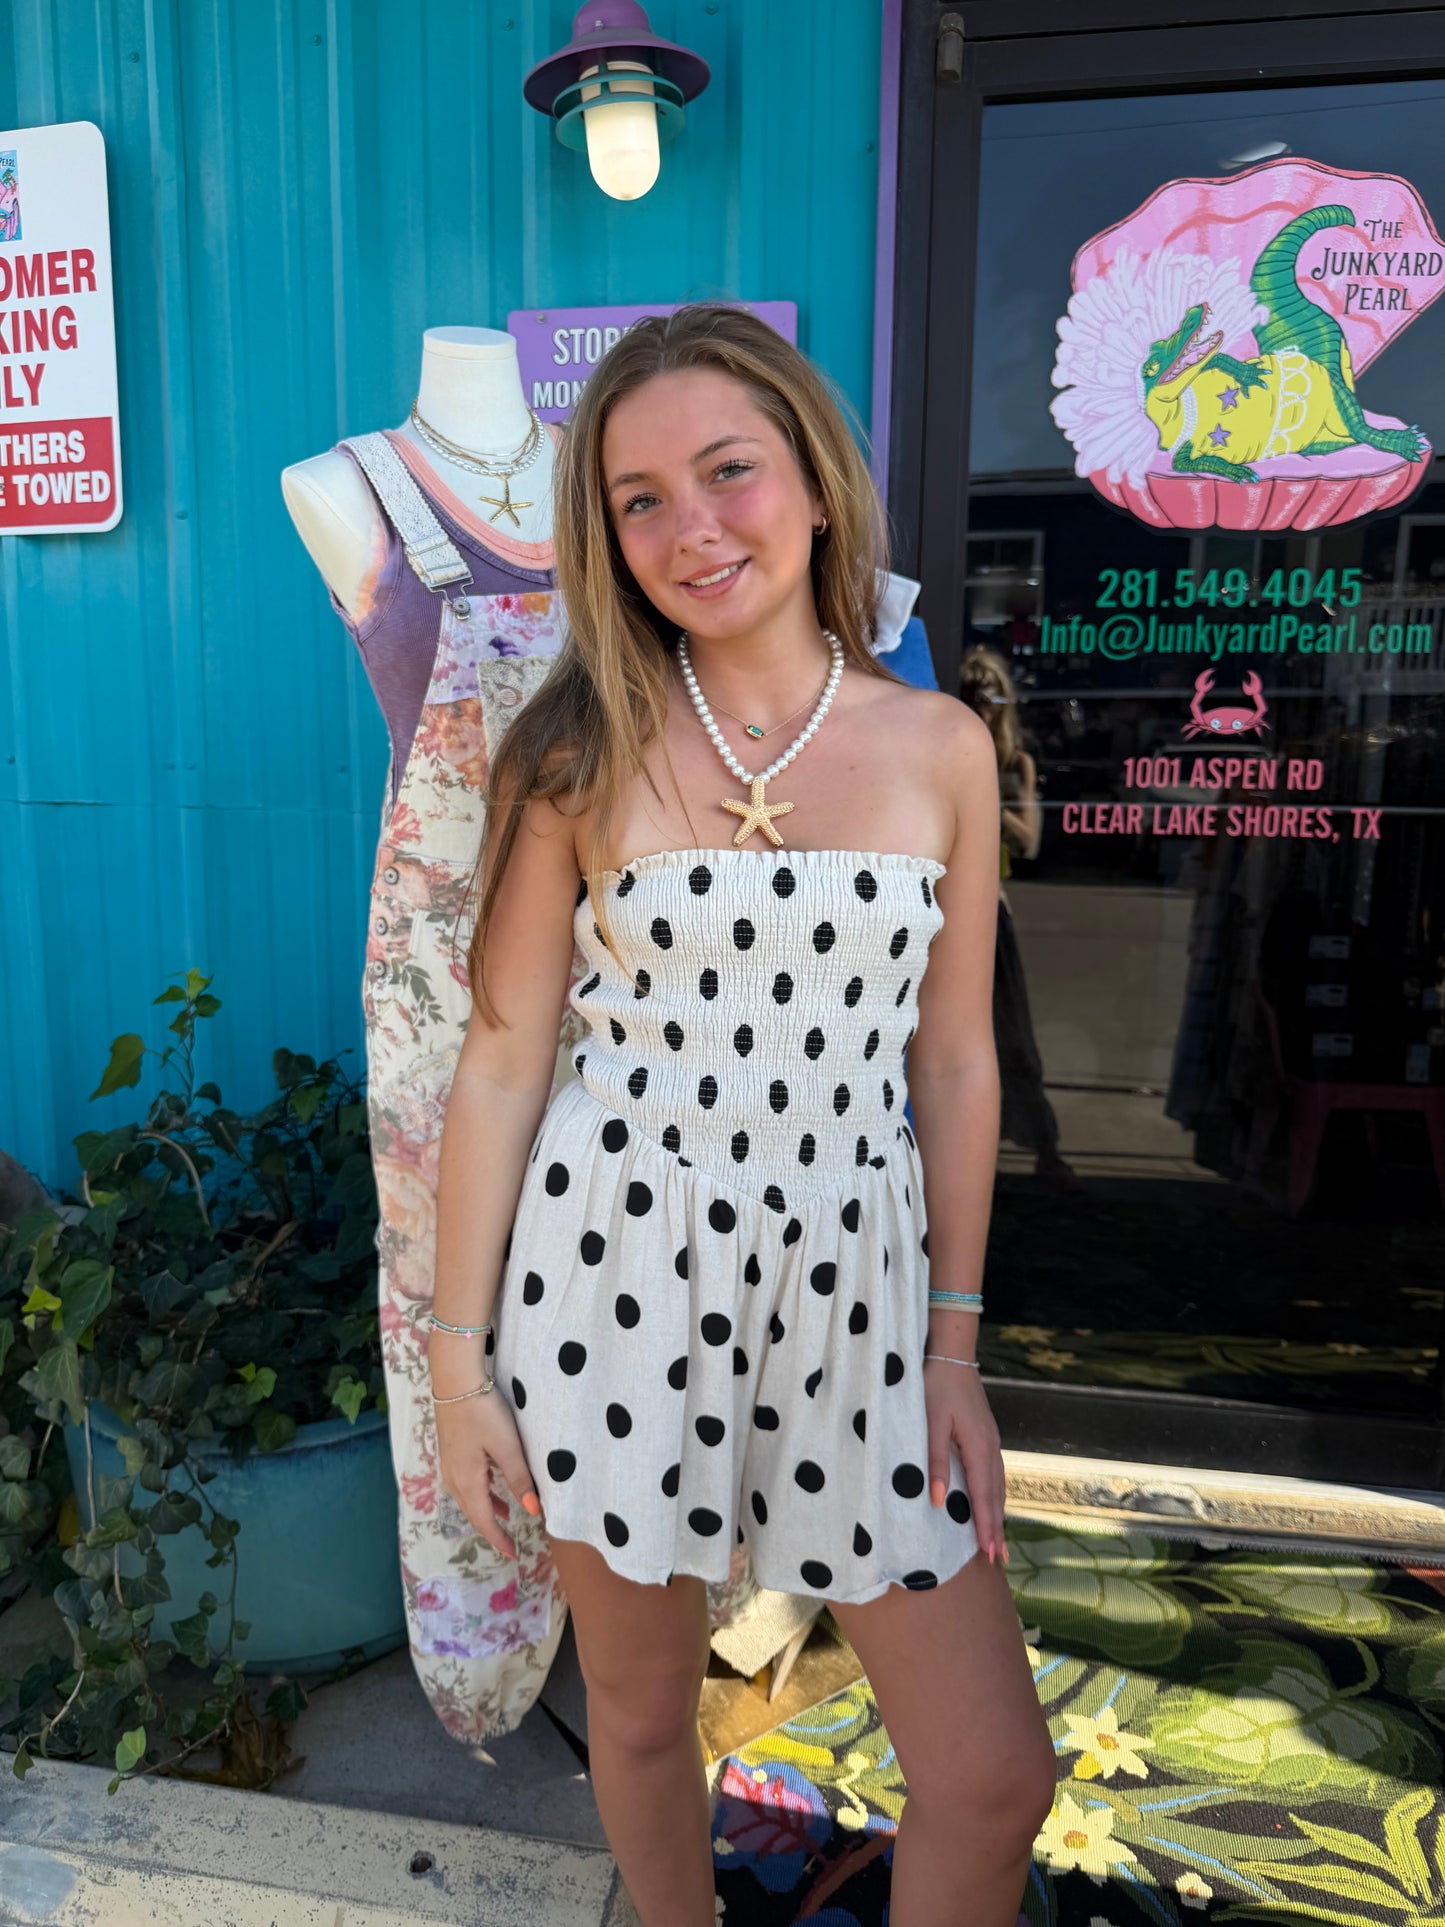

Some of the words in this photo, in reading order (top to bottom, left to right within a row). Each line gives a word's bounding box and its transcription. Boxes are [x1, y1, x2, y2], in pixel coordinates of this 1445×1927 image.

[1363, 219, 1404, 242] THE
[1311, 248, 1443, 281] JUNKYARD
[1344, 284, 1413, 315] PEARL
[553, 327, 636, 366] STOR
[12, 470, 111, 506] TOWED
[1095, 568, 1363, 608] 281.549.4045
[1040, 613, 1433, 661] Info@JunkyardPearl.com
[1123, 756, 1181, 789] 1001
[1188, 757, 1278, 791] ASPEN
[1286, 758, 1324, 791] RD
[1062, 803, 1144, 834] CLEAR
[1152, 804, 1218, 836] LAKE
[1225, 805, 1340, 844] SHORES,
[1350, 808, 1382, 840] TX
